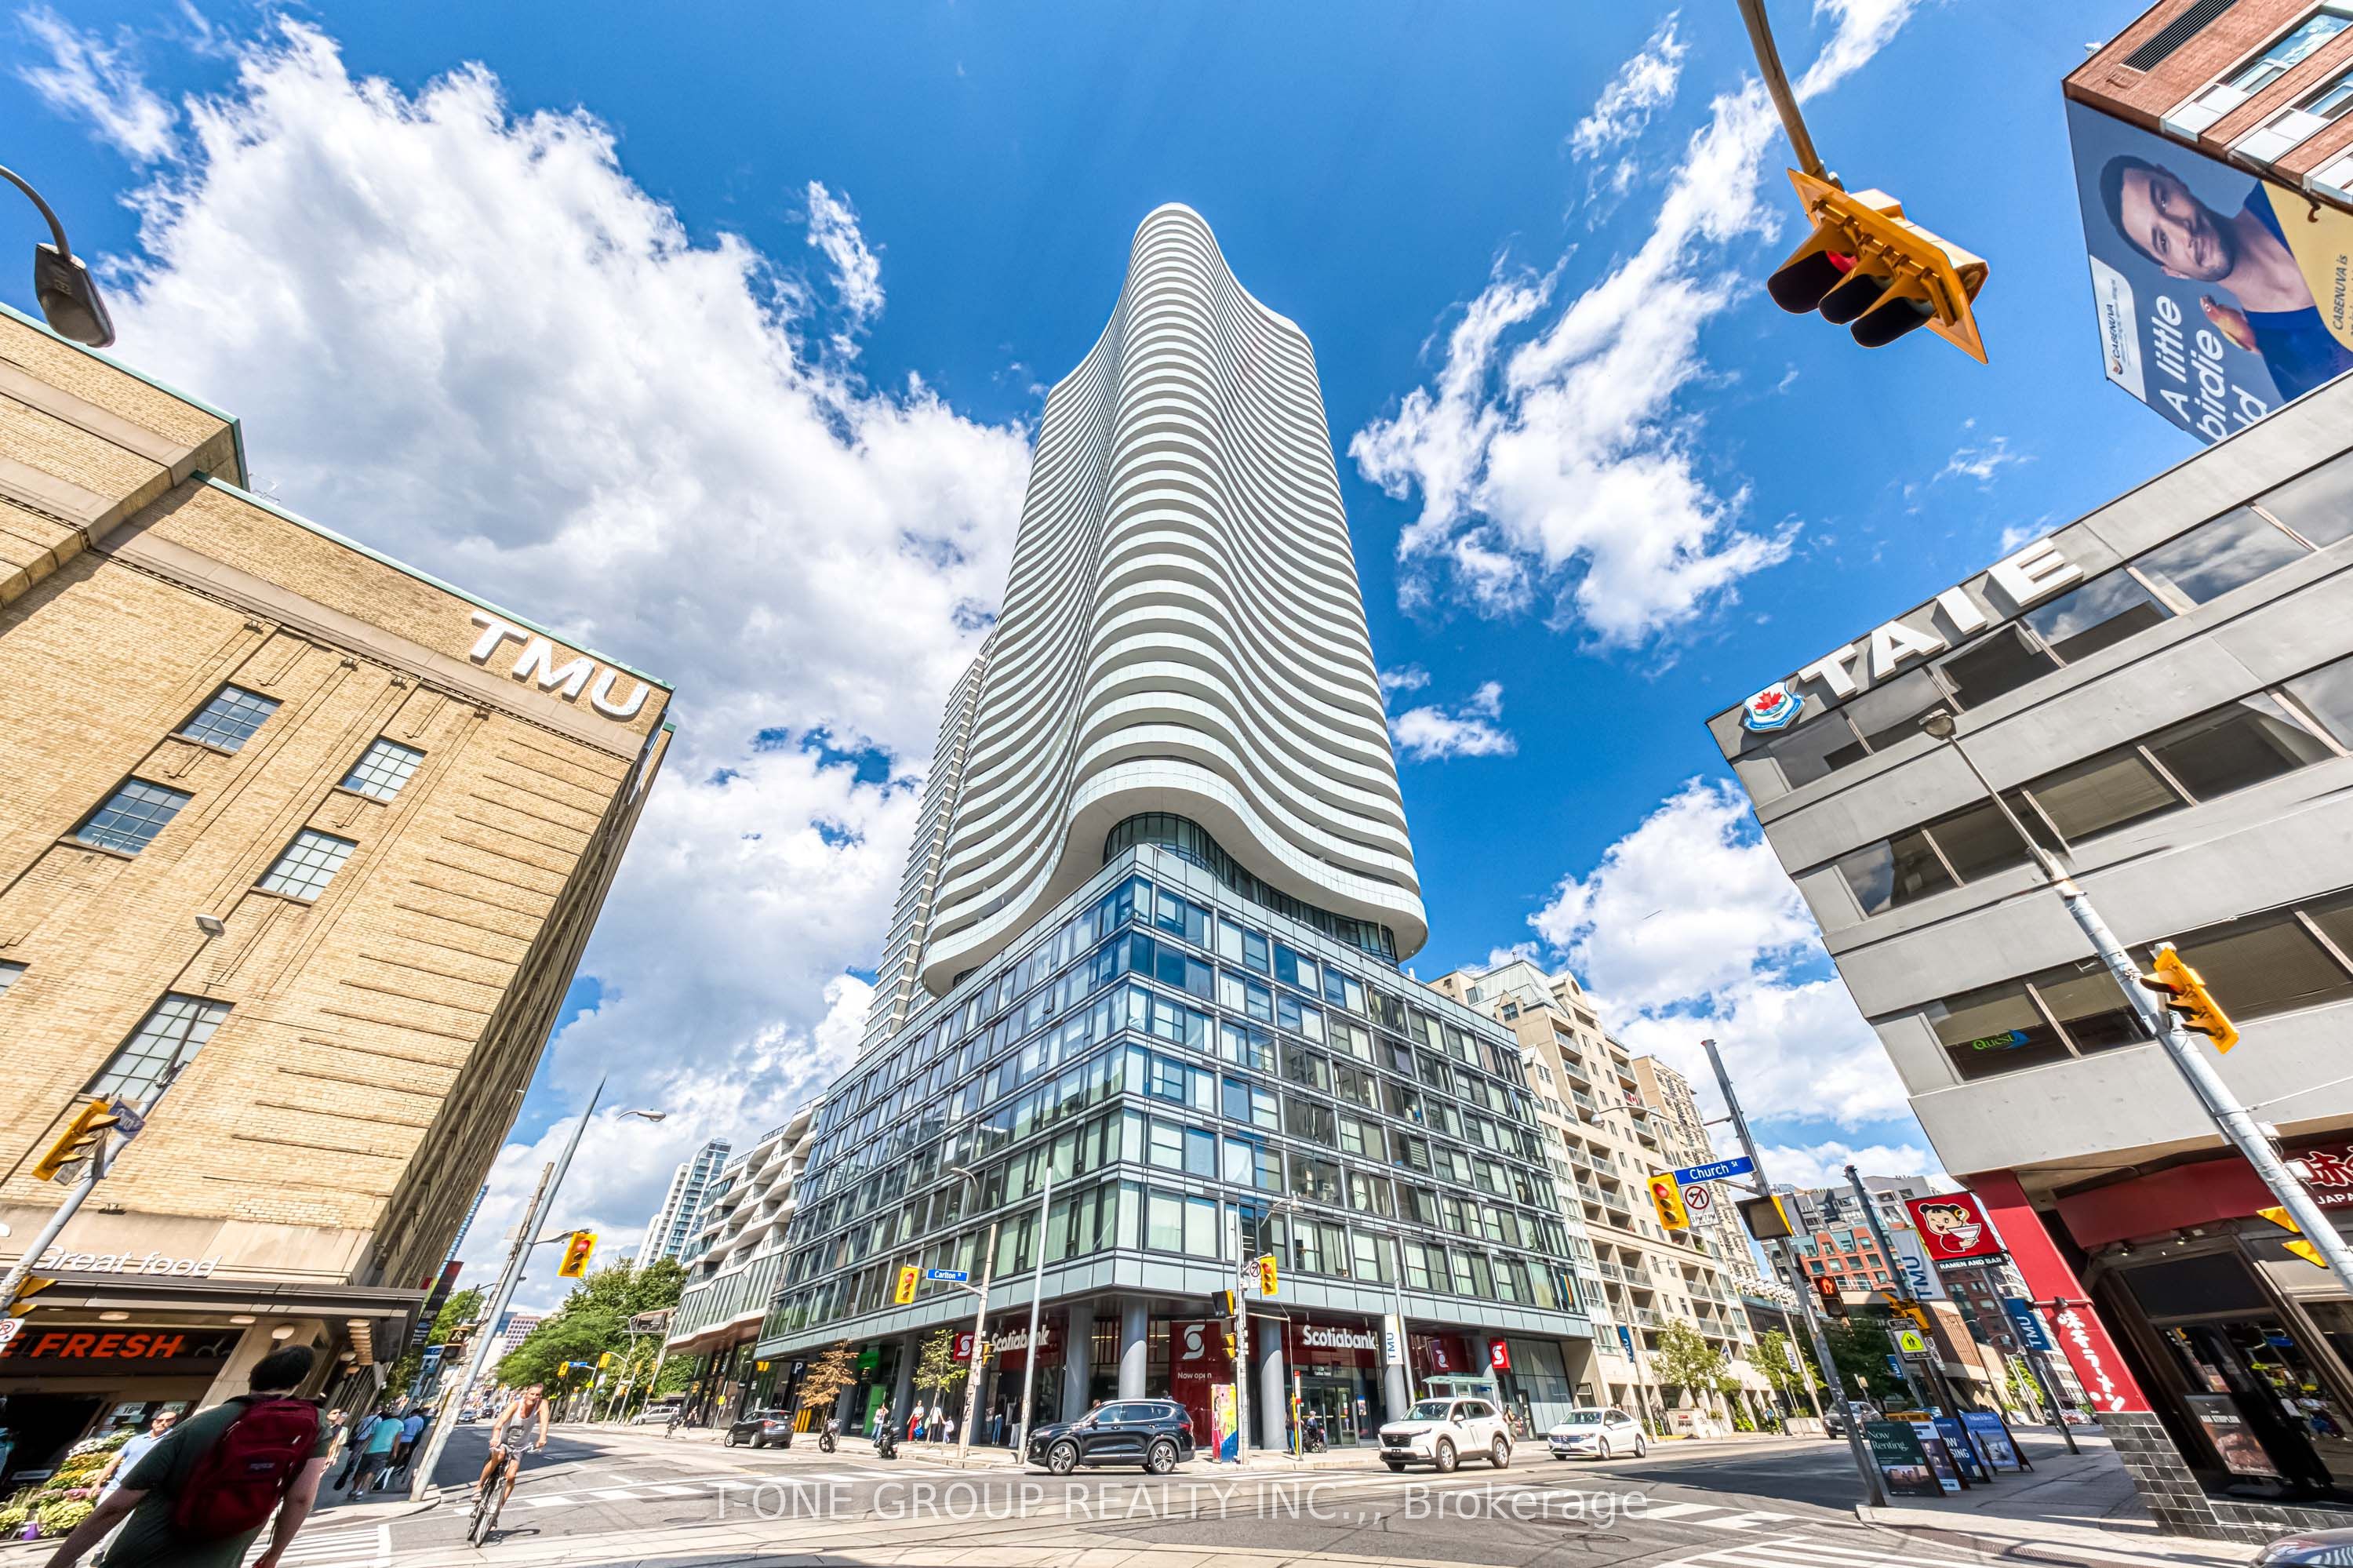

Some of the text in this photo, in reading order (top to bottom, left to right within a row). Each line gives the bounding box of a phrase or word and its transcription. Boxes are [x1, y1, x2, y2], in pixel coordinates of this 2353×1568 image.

[2333, 267, 2347, 330] CABENUVA
[2151, 295, 2191, 424] A little
[2191, 329, 2228, 442] birdie
[1797, 537, 2084, 699] TAIE
[470, 609, 649, 722] TMU
[1689, 1164, 1729, 1180] Church
[33, 1245, 223, 1278] Great food
[934, 1271, 956, 1279] Carlton
[1939, 1261, 1967, 1270] RAMEN
[1902, 1256, 1933, 1302] TMU
[991, 1324, 1050, 1353] Scotiabnk
[1302, 1324, 1377, 1350] Scotiabank
[2017, 1316, 2042, 1347] TMU
[31, 1333, 184, 1358] FRESH
[795, 1362, 803, 1373] P
[1787, 1353, 1798, 1370] TMU
[1890, 1363, 1902, 1378] TMU
[1867, 1431, 1889, 1439] Now
